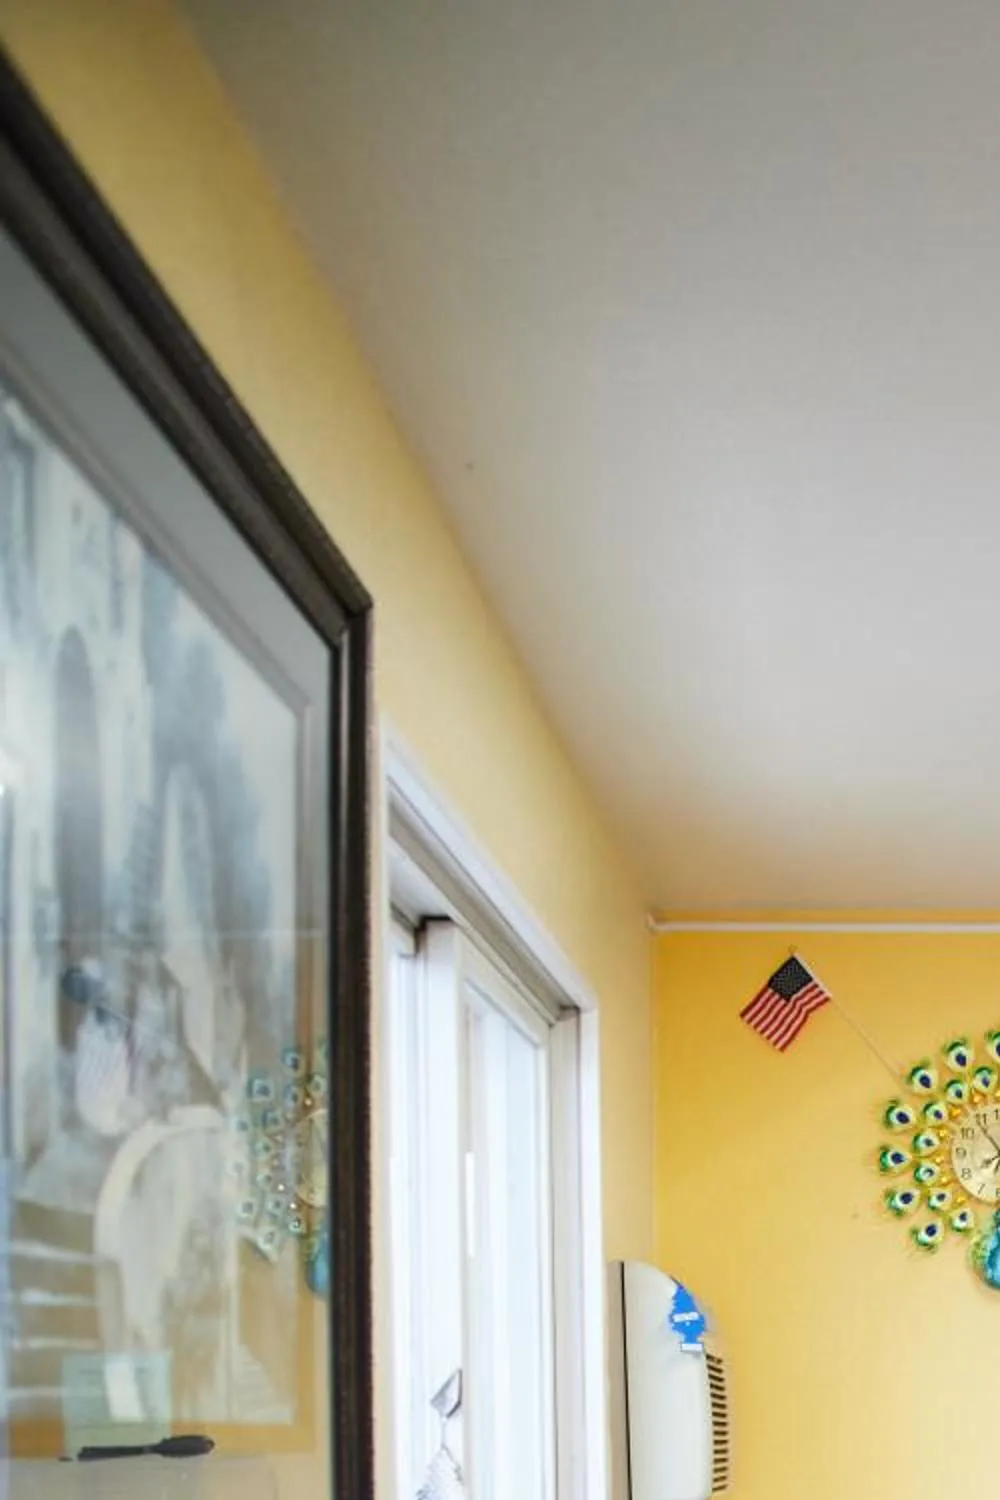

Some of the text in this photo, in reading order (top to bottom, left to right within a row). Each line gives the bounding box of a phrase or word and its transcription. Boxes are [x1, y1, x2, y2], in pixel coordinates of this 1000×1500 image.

[961, 1127, 975, 1139] 10
[955, 1147, 967, 1159] 9
[961, 1167, 972, 1180] 8
[977, 1183, 986, 1194] 7
